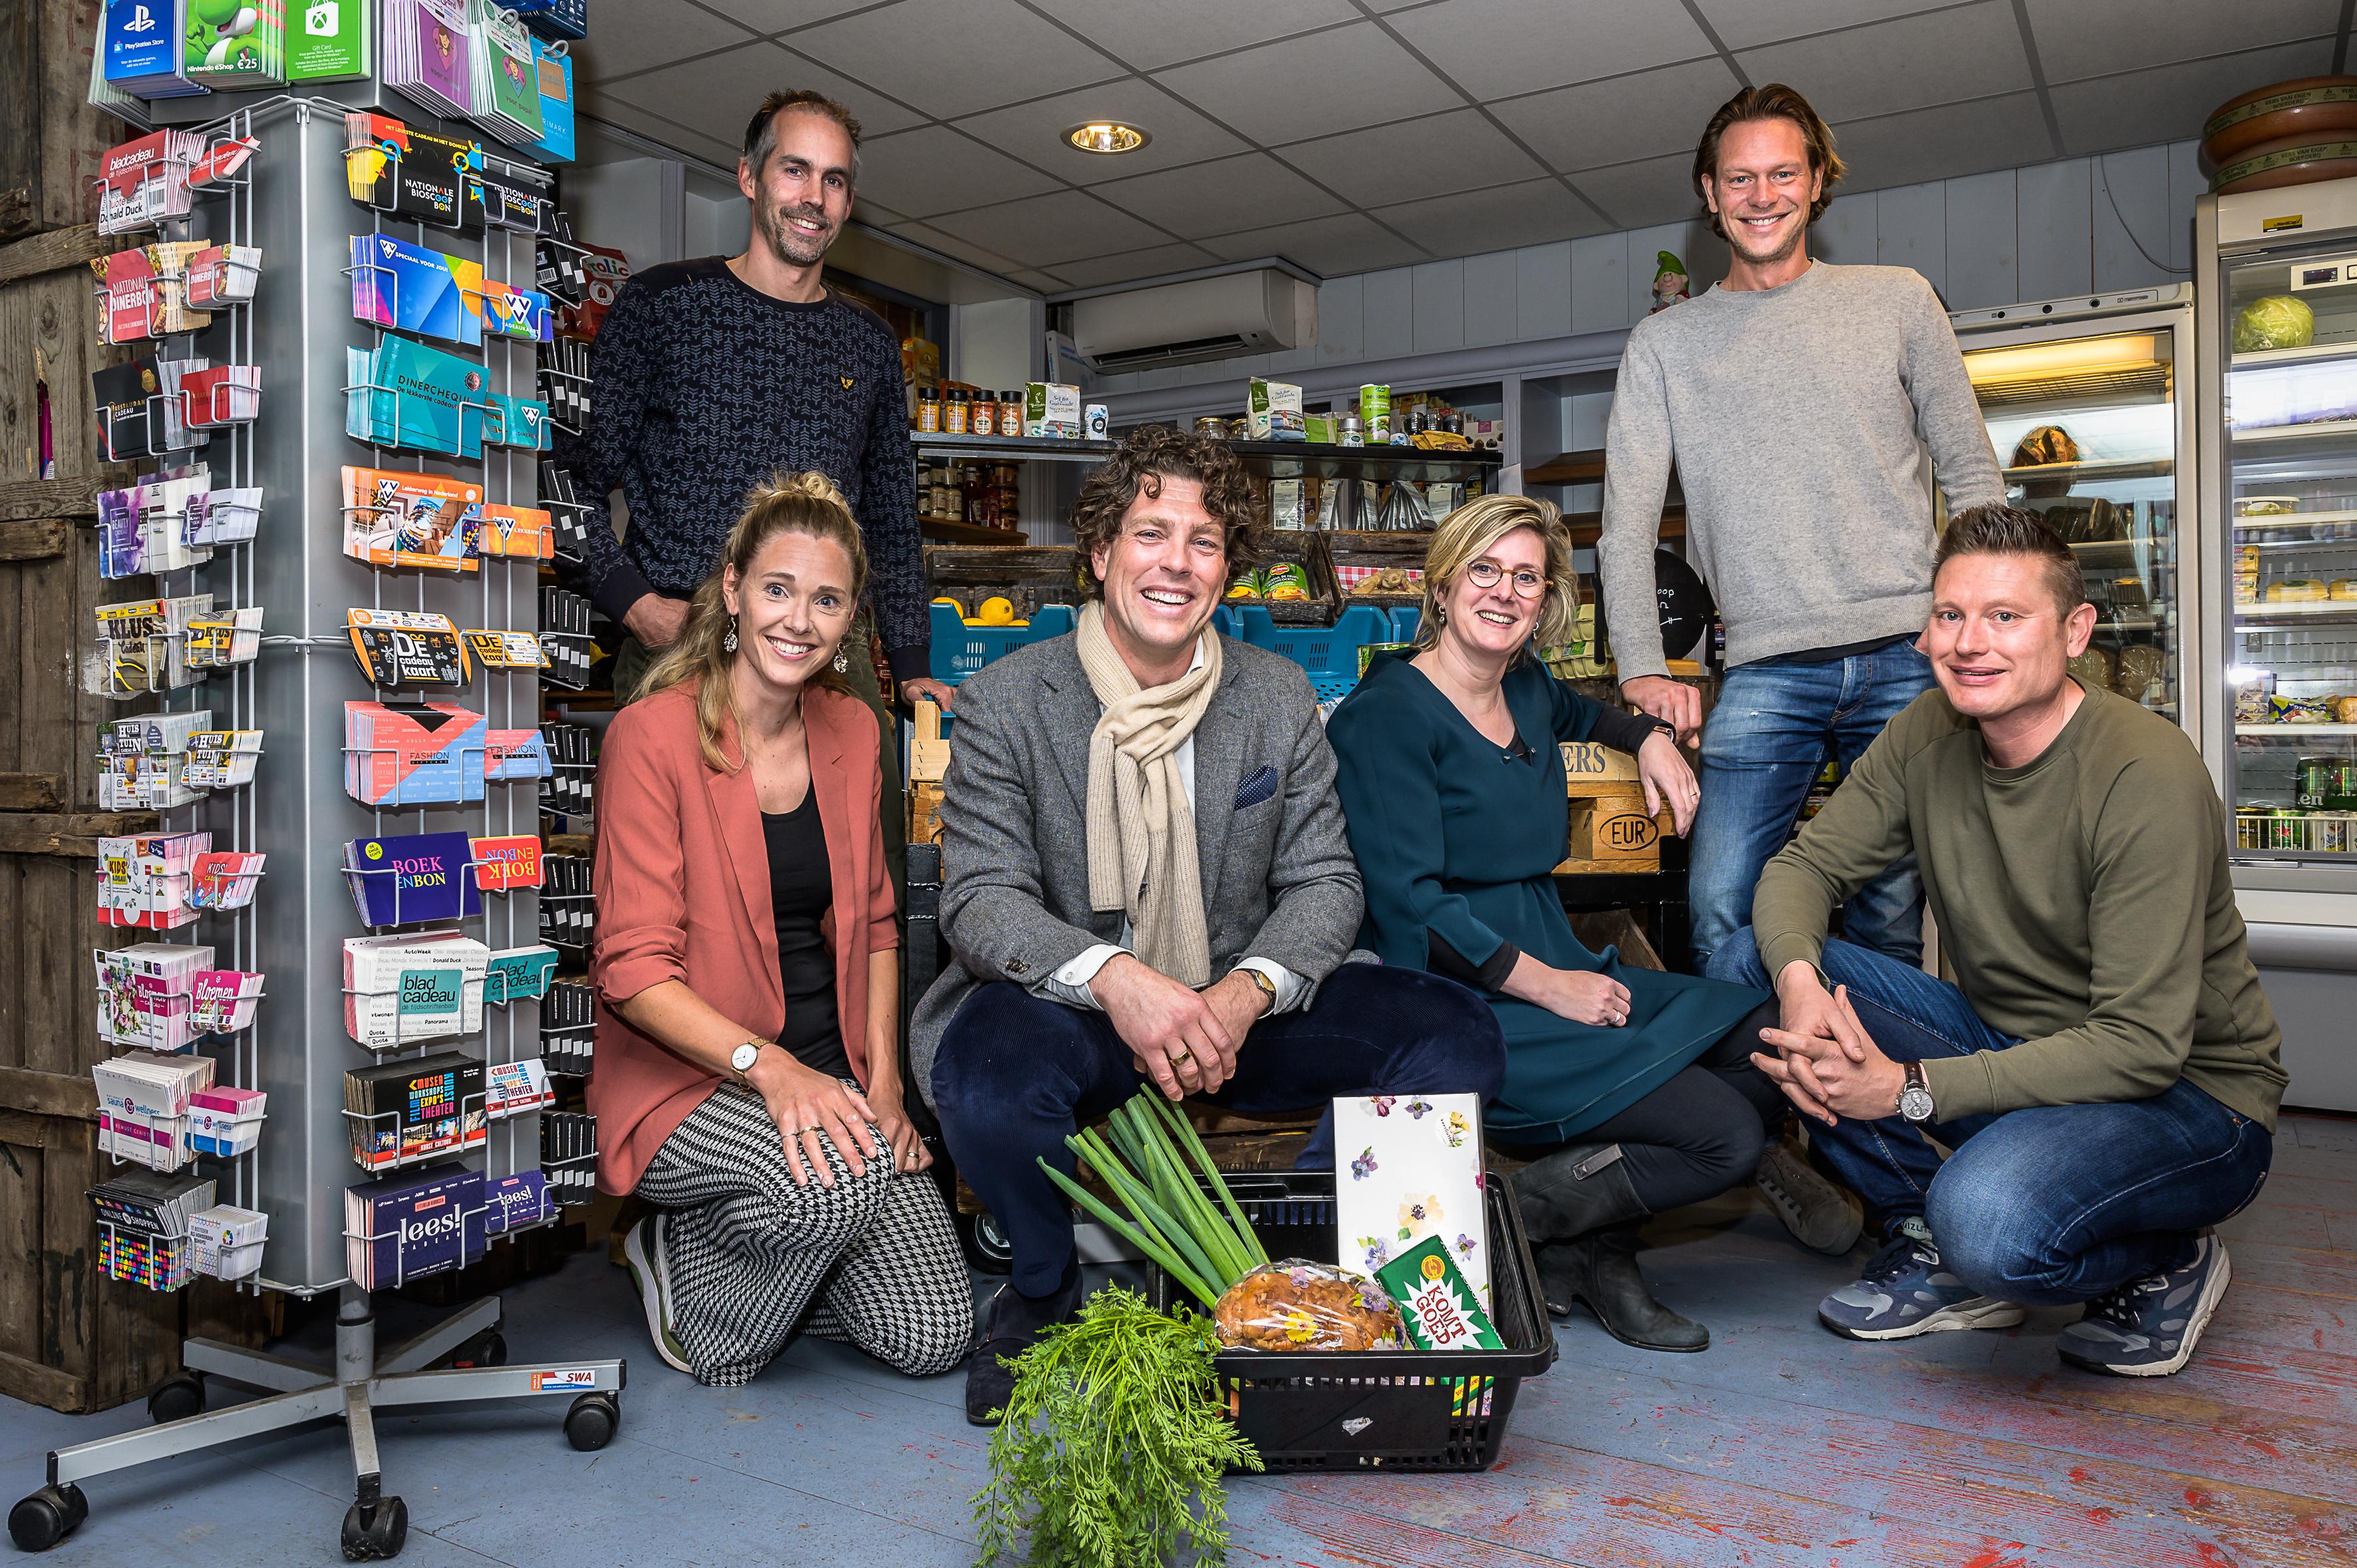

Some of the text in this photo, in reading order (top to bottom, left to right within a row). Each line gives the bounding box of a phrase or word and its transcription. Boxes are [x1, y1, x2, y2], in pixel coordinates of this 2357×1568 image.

[125, 41, 152, 50] PlayStation
[505, 95, 518, 107] voor
[2273, 98, 2304, 110] BOERDERIJ
[543, 116, 567, 134] RIMARK
[395, 126, 414, 136] LEUKSTE
[415, 131, 432, 141] CADEAU
[448, 140, 468, 151] DONKER
[110, 148, 155, 172] bladcadeau
[2288, 152, 2321, 162] BOERDERIJ
[406, 179, 454, 198] NATIONALE
[411, 189, 454, 205] BIOSCOOP
[125, 204, 143, 215] Duck
[434, 202, 451, 213] BON
[520, 207, 537, 217] BON
[395, 251, 448, 273] SPECIAAL VOOR JOU!
[585, 258, 629, 277] rolic
[112, 275, 148, 295] NATIONALE
[396, 385, 406, 394] De
[114, 399, 146, 412] RESTAURAN
[114, 407, 134, 418] CADEAU
[402, 486, 427, 496] Lekkerweg
[433, 489, 458, 498] Nederland
[112, 517, 129, 530] BEAUTY
[514, 528, 546, 537] LEKKERWG
[107, 617, 154, 640] KLUS
[118, 641, 146, 655] Cadeau
[393, 632, 430, 657] DE
[399, 656, 434, 667] cadeau
[401, 664, 438, 678] kaart
[118, 724, 140, 738] HUIS
[118, 738, 142, 752] TUIN
[200, 734, 224, 749] HUIS
[490, 744, 537, 754] FASHION
[1612, 820, 1646, 845] EUR
[109, 860, 128, 873] KIDS'
[207, 862, 228, 874] KIDS'
[392, 856, 444, 875] BOEK
[496, 961, 527, 979] blad
[196, 978, 234, 1002] Bloemen
[404, 975, 437, 991] blad
[402, 989, 456, 1003] cadeau
[410, 1003, 454, 1011] tijdschriftenbon
[496, 1064, 518, 1076] MUSEA
[516, 1063, 531, 1085] KUNST
[416, 1075, 444, 1090] MUSEA
[444, 1072, 454, 1102] KUNST
[409, 1086, 444, 1099] WORKSHOPS
[507, 1084, 534, 1098] THEATER
[107, 1096, 124, 1108] sauna
[135, 1105, 160, 1116] wellness
[420, 1095, 444, 1108] EXPO'S
[409, 1098, 420, 1123] FILM
[421, 1102, 454, 1120] THEATER
[497, 1185, 533, 1206] lees!
[100, 1208, 160, 1231] ONLINE SHOPPEN
[400, 1203, 460, 1244] lees!
[196, 1232, 214, 1242] HONDERDEN
[401, 1233, 460, 1254] CADEAU
[1426, 1284, 1467, 1339] KOMT
[1416, 1296, 1451, 1344] GOED
[566, 1372, 591, 1382] SWA
